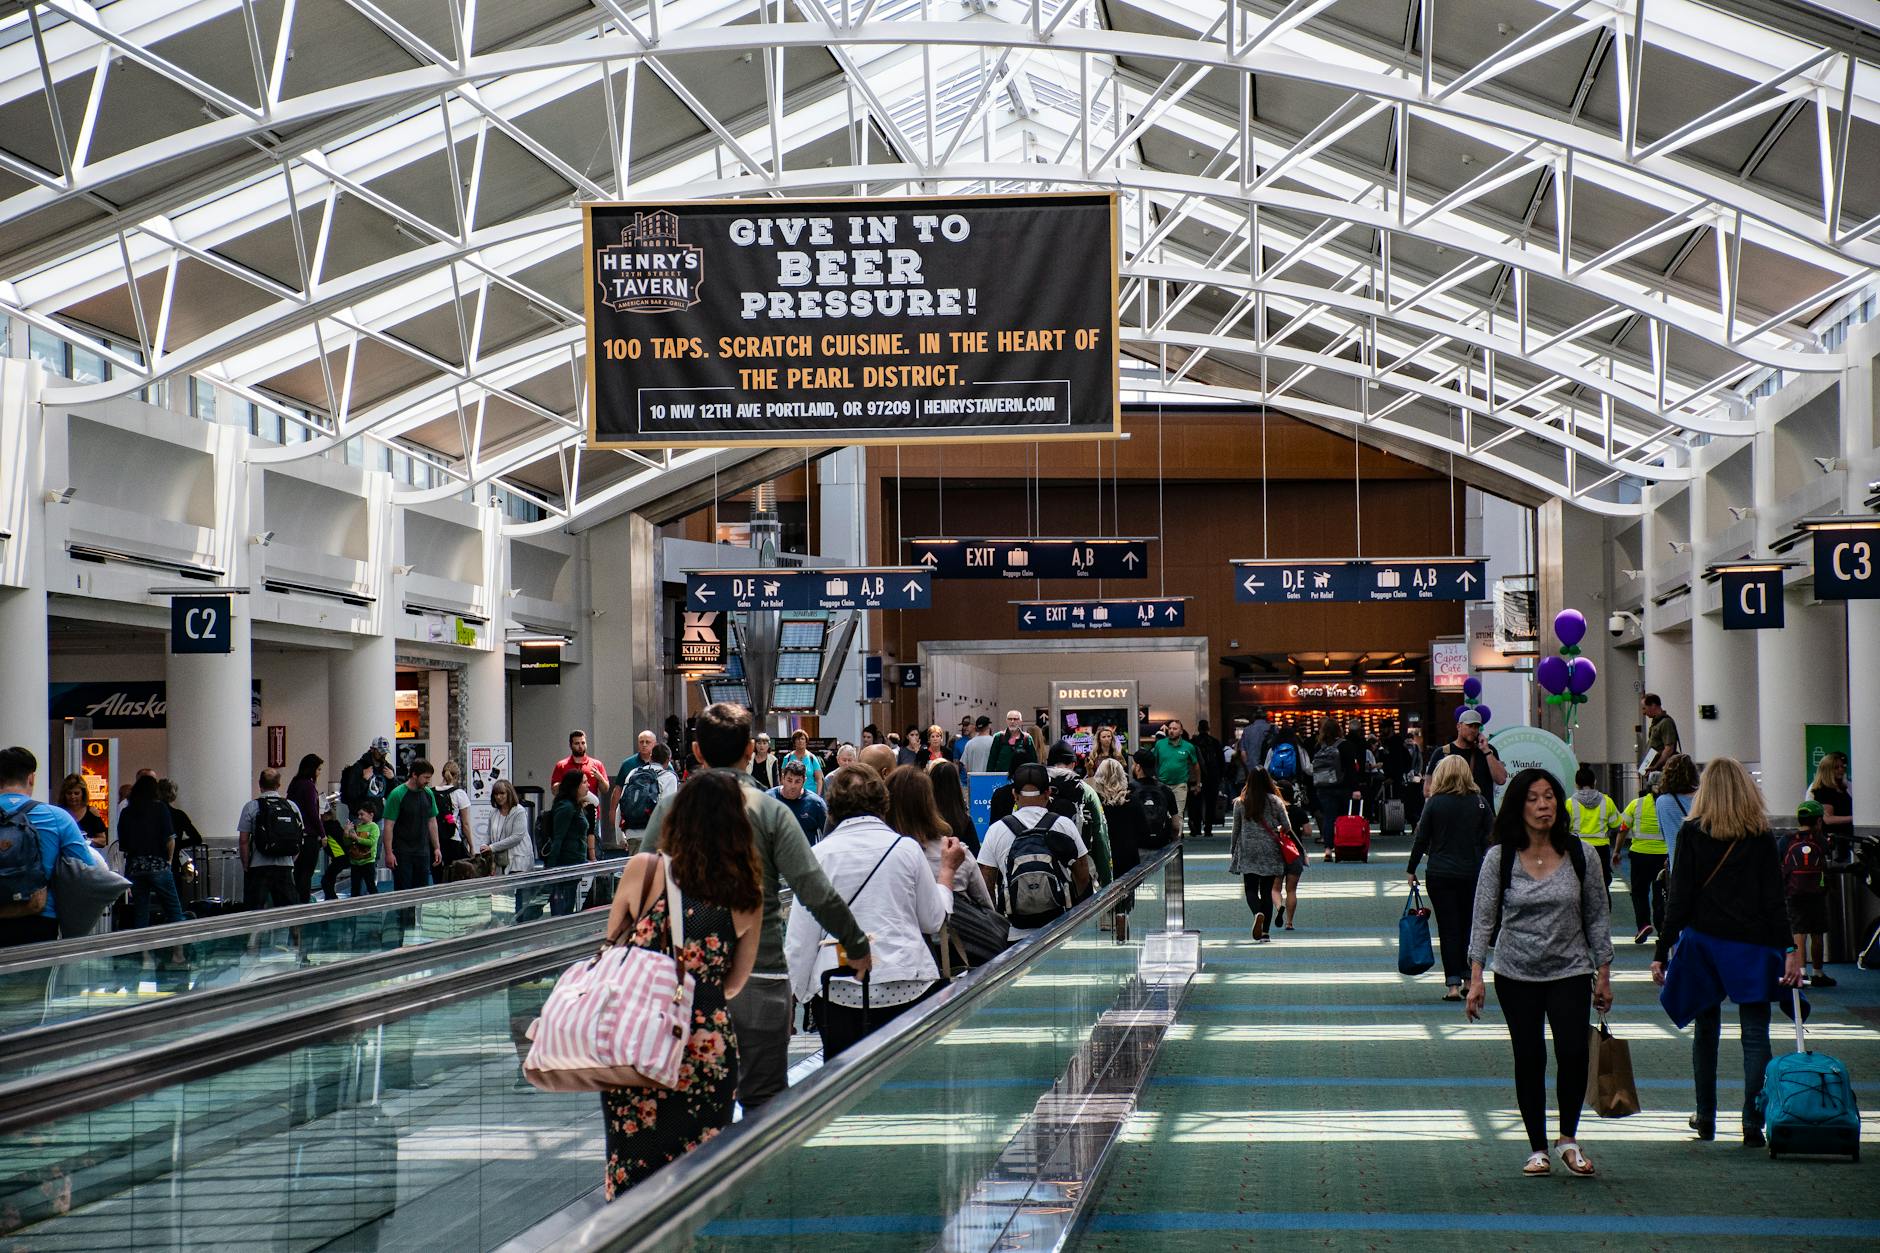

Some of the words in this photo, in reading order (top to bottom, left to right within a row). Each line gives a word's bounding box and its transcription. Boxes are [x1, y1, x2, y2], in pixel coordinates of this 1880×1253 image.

[729, 218, 834, 246] GIVE
[849, 216, 897, 244] IN
[913, 214, 971, 243] TO
[603, 251, 698, 271] HENRY'S
[777, 248, 925, 287] BEER
[612, 278, 688, 298] TAVERN
[618, 300, 649, 309] AMERICAN
[740, 288, 977, 319] PRESSURE!
[603, 338, 642, 360] 100
[650, 337, 709, 359] TAPS.
[718, 336, 812, 359] SCRATCH
[821, 334, 910, 357] CUISINE.
[919, 333, 940, 354] IN
[949, 332, 988, 353] THE
[997, 330, 1066, 352] HEART
[1074, 329, 1100, 350] OF
[739, 368, 778, 390] THE
[787, 367, 854, 388] PEARL
[863, 365, 966, 388] DISTRICT.
[650, 405, 666, 419] 10
[670, 404, 695, 419] NW
[699, 403, 732, 418] 12TH
[736, 403, 761, 418] AVE
[766, 402, 838, 419] PORTLAND,
[842, 401, 862, 416] OR
[867, 400, 911, 415] 97209
[924, 397, 1056, 415] HENRYSTAVERN.COM
[966, 547, 995, 567] EXIT
[1071, 547, 1095, 570] A,B
[1832, 541, 1872, 581] C3
[1003, 570, 1021, 578] Baggage
[1282, 570, 1305, 592] D,E
[1412, 568, 1438, 590] A,B
[733, 578, 755, 600] D,E
[860, 577, 885, 599] A,B
[1286, 591, 1301, 599] Gates
[1310, 591, 1320, 599] Pet
[1320, 590, 1335, 599] Relief
[1370, 591, 1392, 599] Baggage
[1393, 590, 1407, 598] Claim
[1418, 590, 1433, 598] Gates
[1740, 582, 1767, 615] C1
[737, 600, 751, 608] Gates
[761, 600, 770, 608] Pet
[770, 600, 784, 608] Relief
[819, 600, 841, 608] Baggage
[841, 599, 855, 607] Claim
[866, 599, 880, 607] Gates
[1046, 607, 1068, 621] EXIT
[1137, 605, 1155, 622] A,B
[185, 607, 217, 640] C2
[682, 645, 721, 655] KIEHL'S
[1434, 652, 1468, 664] Capers
[1440, 663, 1462, 674] Café
[1059, 688, 1128, 699] DIRECTORY
[1288, 684, 1323, 698] Capers
[1324, 683, 1347, 697] Wine
[1348, 684, 1368, 697] Bar
[85, 692, 167, 719] Alaska
[87, 743, 104, 757] O
[1511, 760, 1542, 768] Wander
